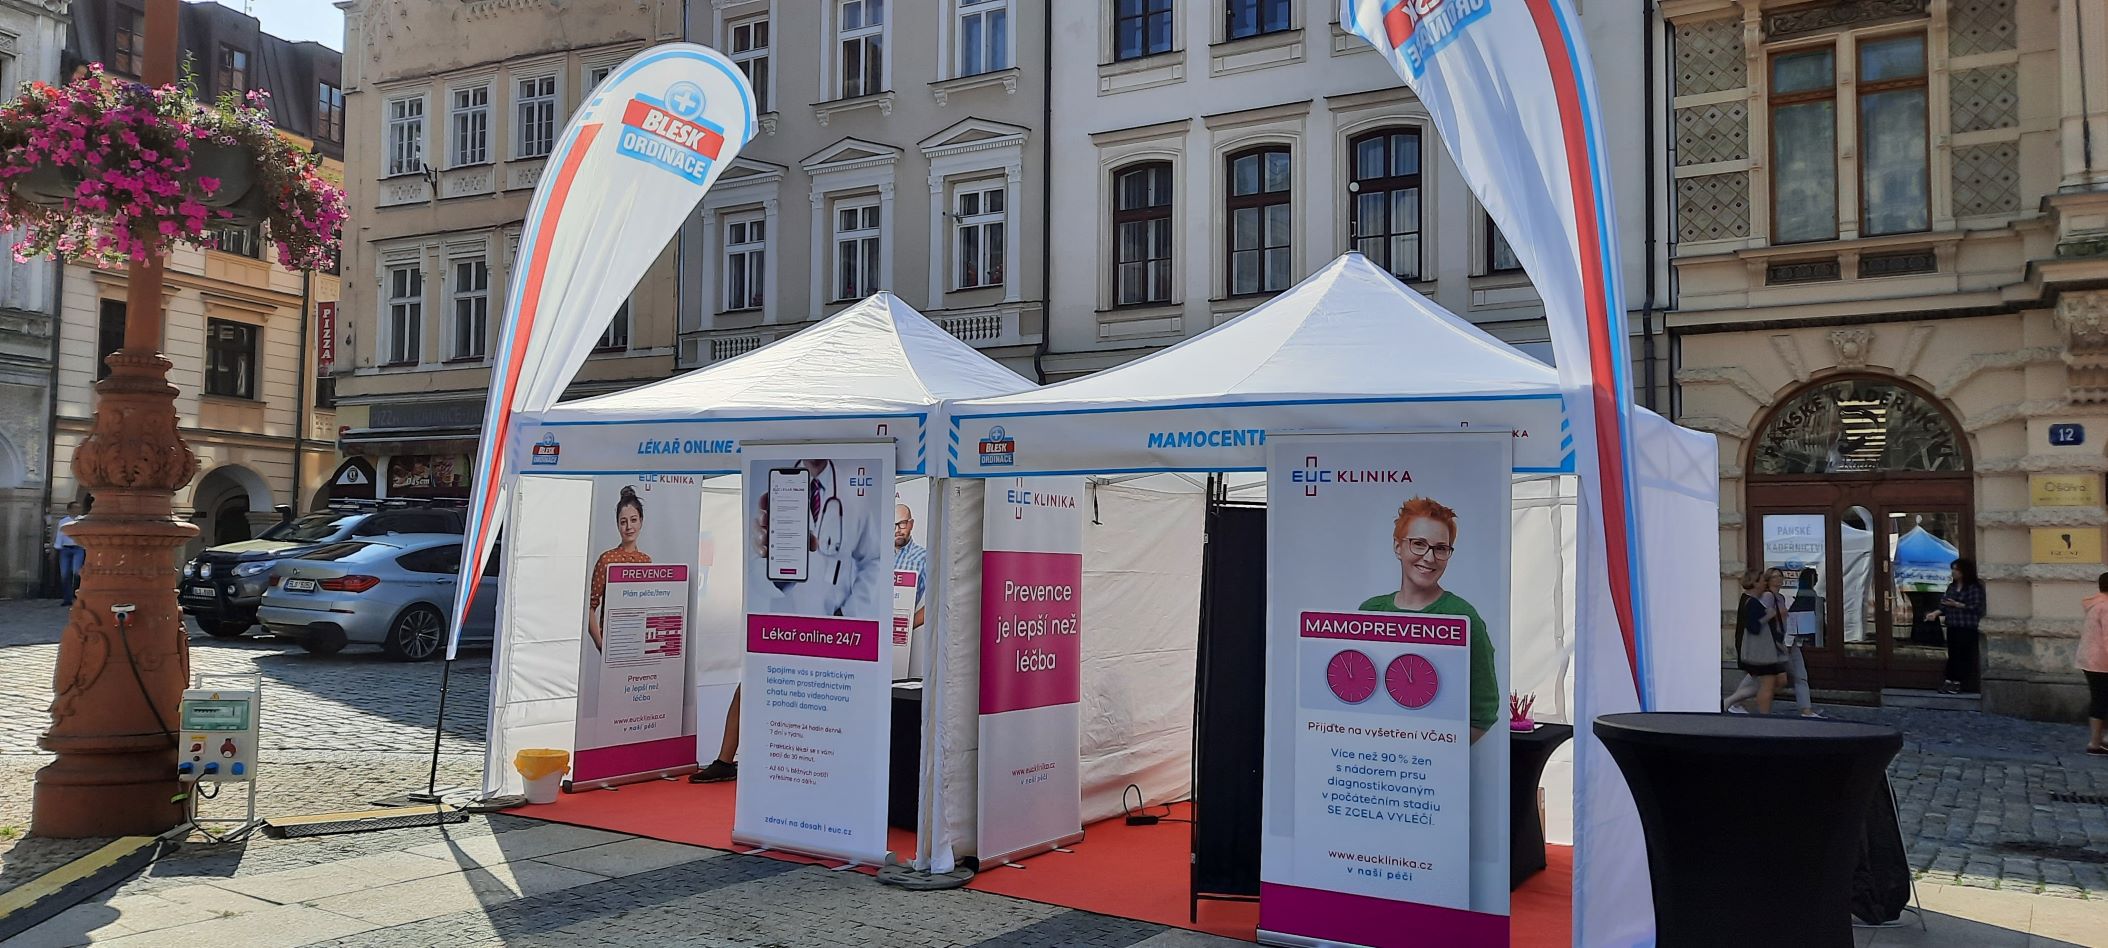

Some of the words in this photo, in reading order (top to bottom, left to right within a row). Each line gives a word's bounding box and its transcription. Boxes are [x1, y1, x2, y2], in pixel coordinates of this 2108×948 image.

[642, 109, 706, 150] BLESK
[623, 132, 706, 178] ORDINACE
[322, 308, 332, 359] PIZZA
[2059, 428, 2074, 441] 12
[637, 438, 680, 455] LÉKAŘ
[683, 439, 732, 454] ONLINE
[986, 442, 1007, 453] BLESK
[981, 454, 1013, 464] ORDINACE
[659, 475, 694, 485] KLINIKA
[850, 477, 873, 487] EUC
[1292, 470, 1331, 483] EUC
[1337, 470, 1413, 483] KLINIKA
[1007, 489, 1031, 505] EUC
[1034, 492, 1076, 509] KLINIKA
[622, 568, 674, 579] PREVENCE
[623, 589, 638, 597] Plán
[1005, 580, 1072, 602] Prevence
[762, 627, 797, 641] Lékař
[800, 630, 834, 644] online
[835, 632, 861, 646] 24/7
[996, 616, 1010, 643] je
[1014, 614, 1048, 641] lepší
[1051, 613, 1077, 635] než
[1305, 618, 1461, 640] MAMOPREVENCE
[1016, 648, 1056, 673] léčba
[627, 674, 657, 682] Prevence
[766, 677, 795, 687] lékařem
[815, 670, 855, 681] praktickým
[632, 683, 648, 693] lepší
[766, 688, 788, 698] chatu
[789, 690, 806, 698] nebo
[806, 691, 850, 703] videohovoru
[772, 700, 798, 710] pohodlí
[1348, 727, 1362, 735] na
[1365, 726, 1418, 740] vyšetření
[1420, 729, 1457, 743] VČAS!
[1331, 747, 1355, 759] Více
[1358, 751, 1378, 761] než
[1411, 755, 1432, 766] žen
[1336, 764, 1342, 772] s
[1344, 764, 1397, 778] nádorem
[1400, 770, 1426, 781] prsu
[1327, 776, 1435, 797] diagnostikovaným
[1331, 792, 1400, 807] počátečním
[1403, 799, 1441, 812] stadiu
[1327, 804, 1342, 815] SE
[1345, 806, 1384, 820] ZCELA
[764, 815, 787, 826] zdraví
[800, 820, 822, 831] dosah
[828, 826, 853, 836] euc.cz
[1328, 850, 1433, 871] www.eucklinika.cz
[1357, 865, 1382, 878] naší
[1387, 869, 1413, 881] péčí
